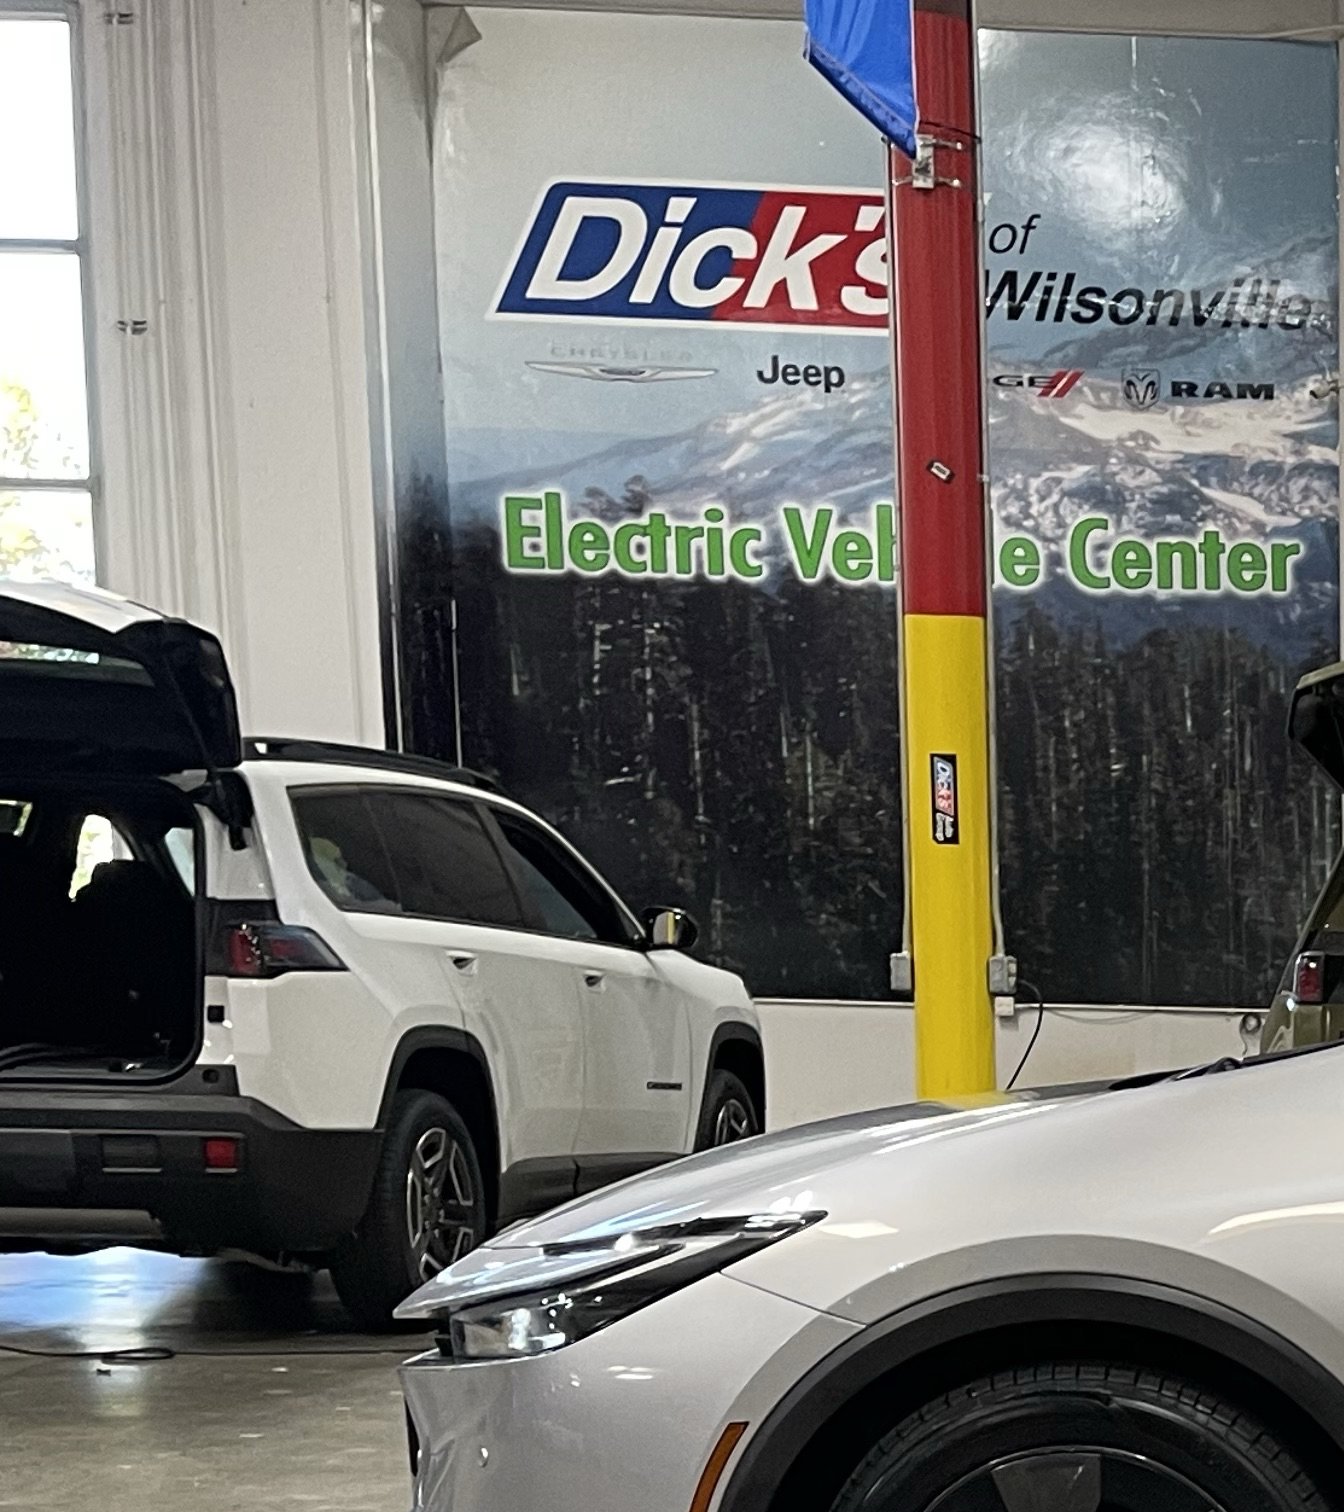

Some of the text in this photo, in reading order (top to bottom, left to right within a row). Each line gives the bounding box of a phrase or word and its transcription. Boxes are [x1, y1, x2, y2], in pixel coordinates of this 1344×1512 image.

[525, 195, 889, 316] Dick's
[988, 213, 1041, 255] of
[985, 268, 1312, 330] Wilsonville
[757, 355, 845, 393] Jeep
[1170, 380, 1275, 400] RAM
[504, 491, 763, 577] Electric
[1069, 517, 1300, 593] Center
